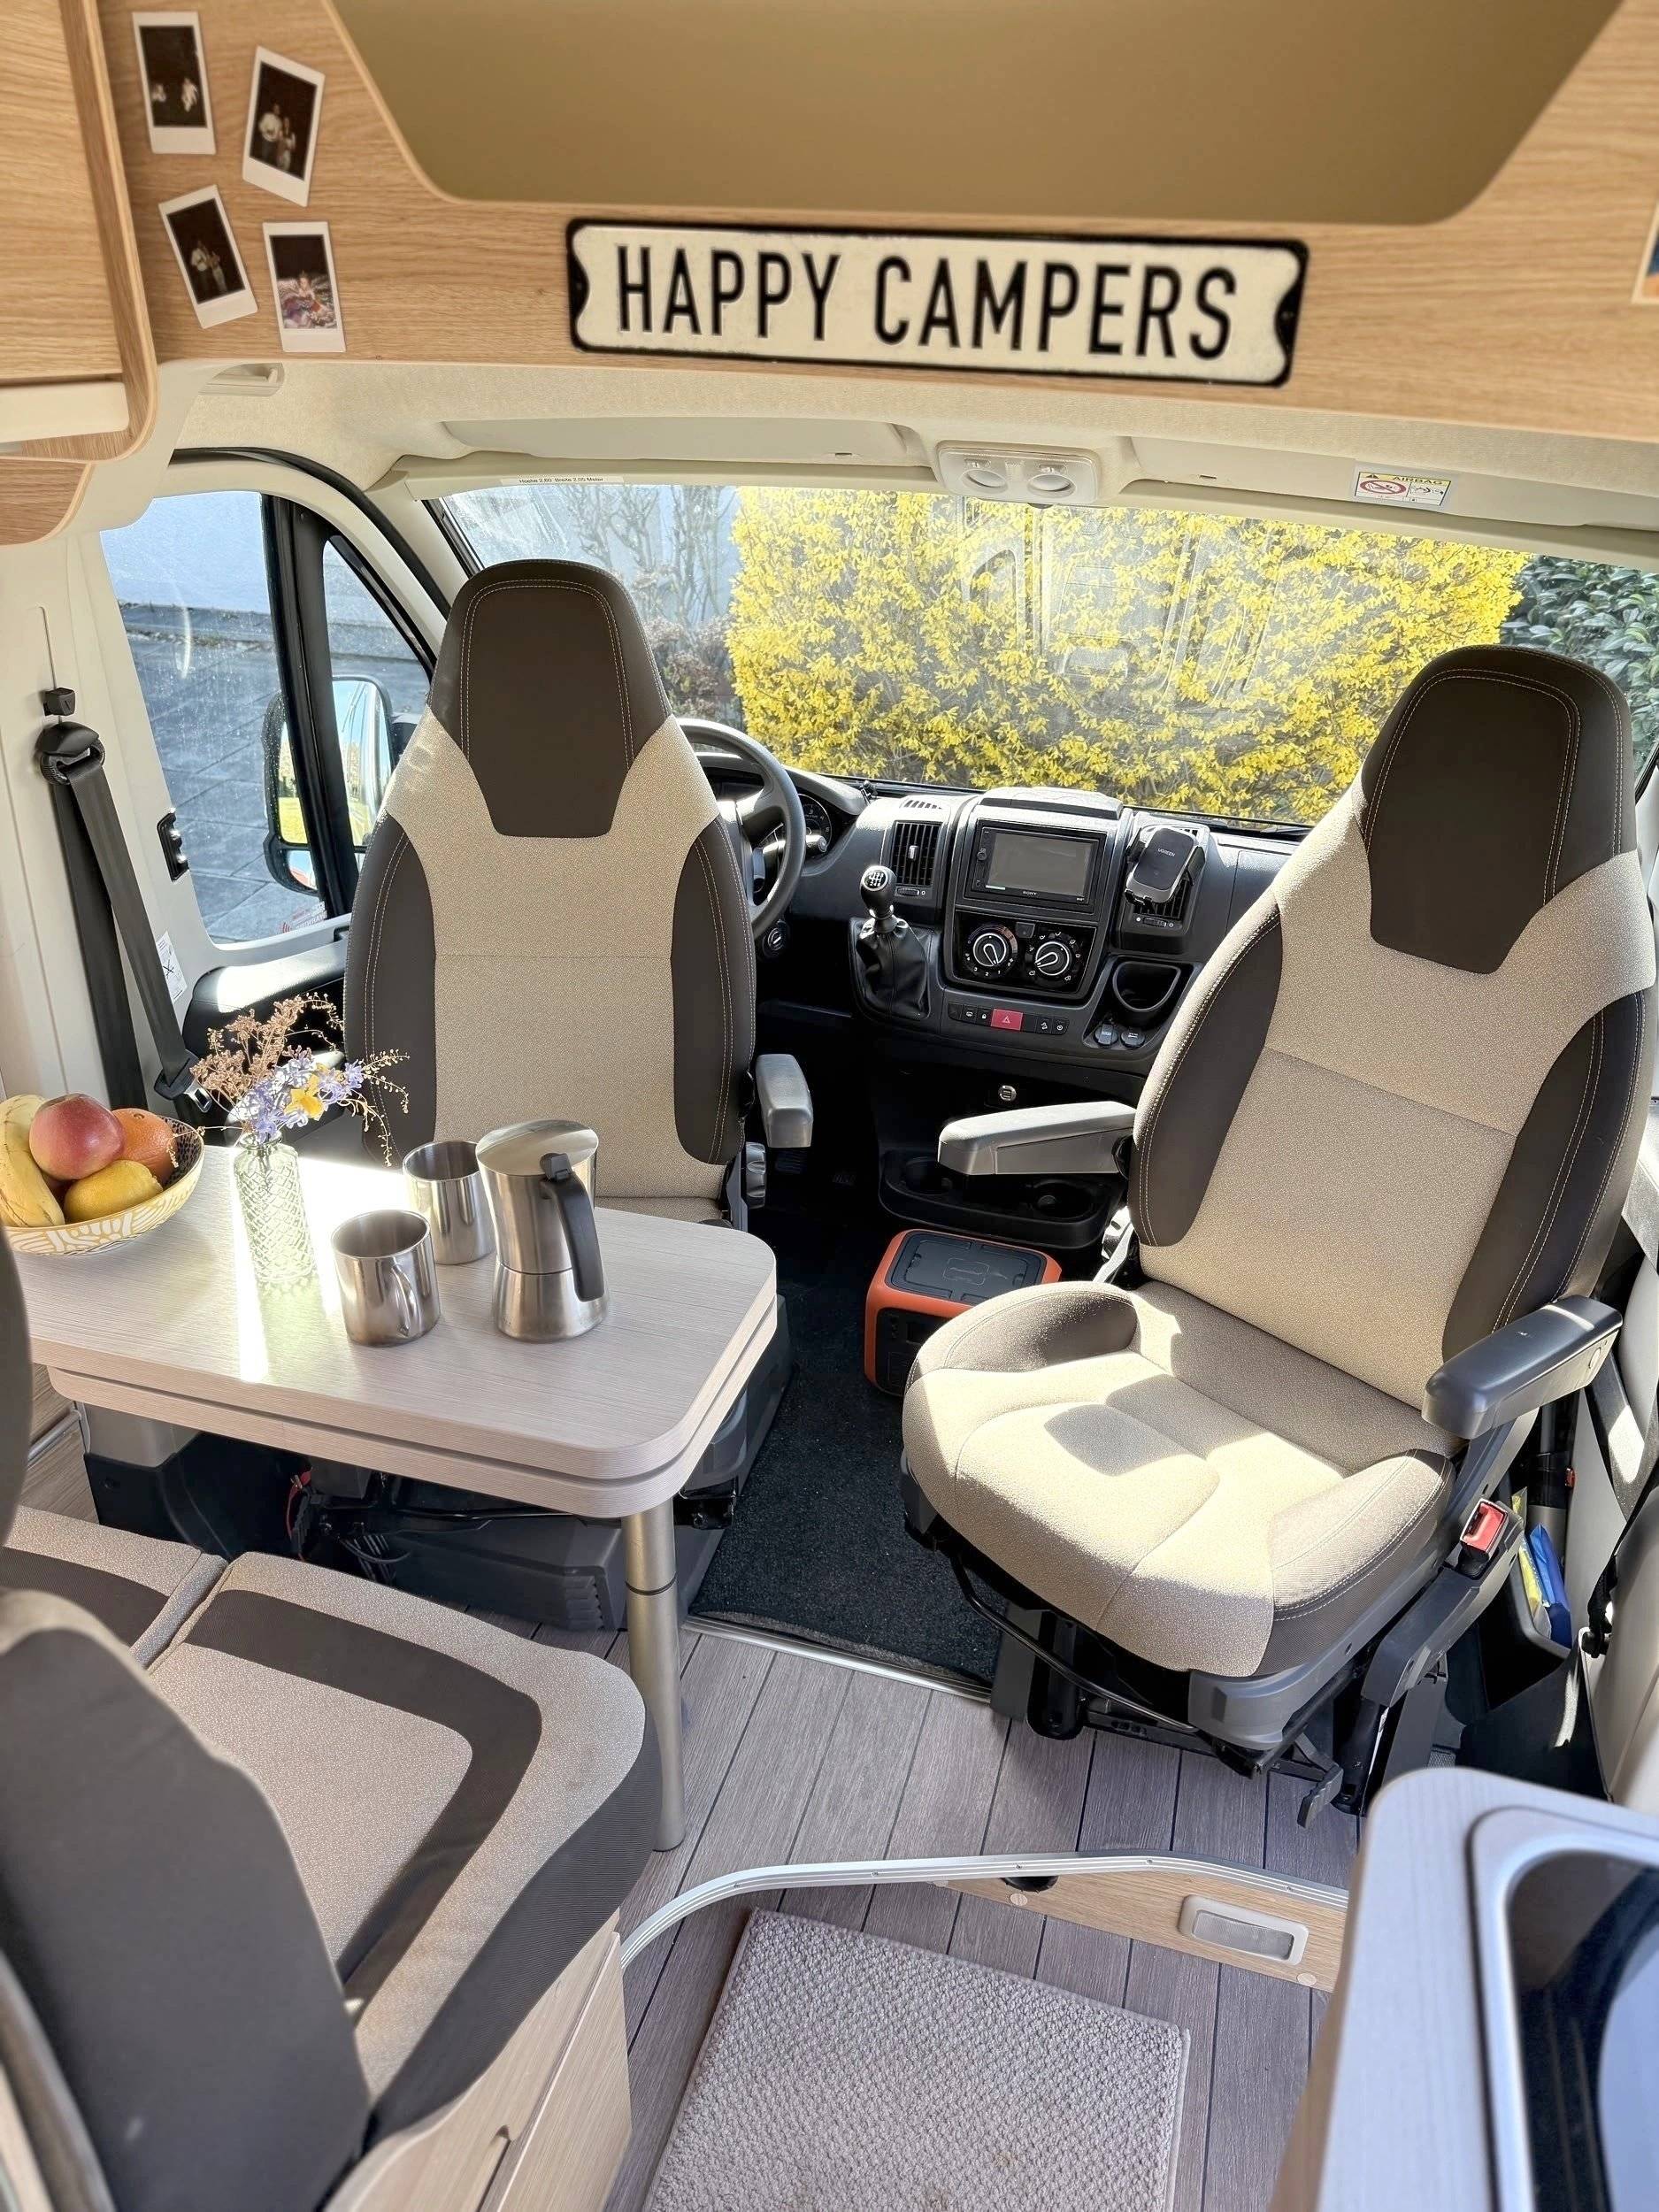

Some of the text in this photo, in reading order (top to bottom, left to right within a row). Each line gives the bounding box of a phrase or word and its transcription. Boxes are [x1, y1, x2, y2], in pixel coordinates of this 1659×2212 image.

[617, 244, 1237, 361] HAPPY CAMPERS
[1393, 476, 1443, 485] AIRBAG
